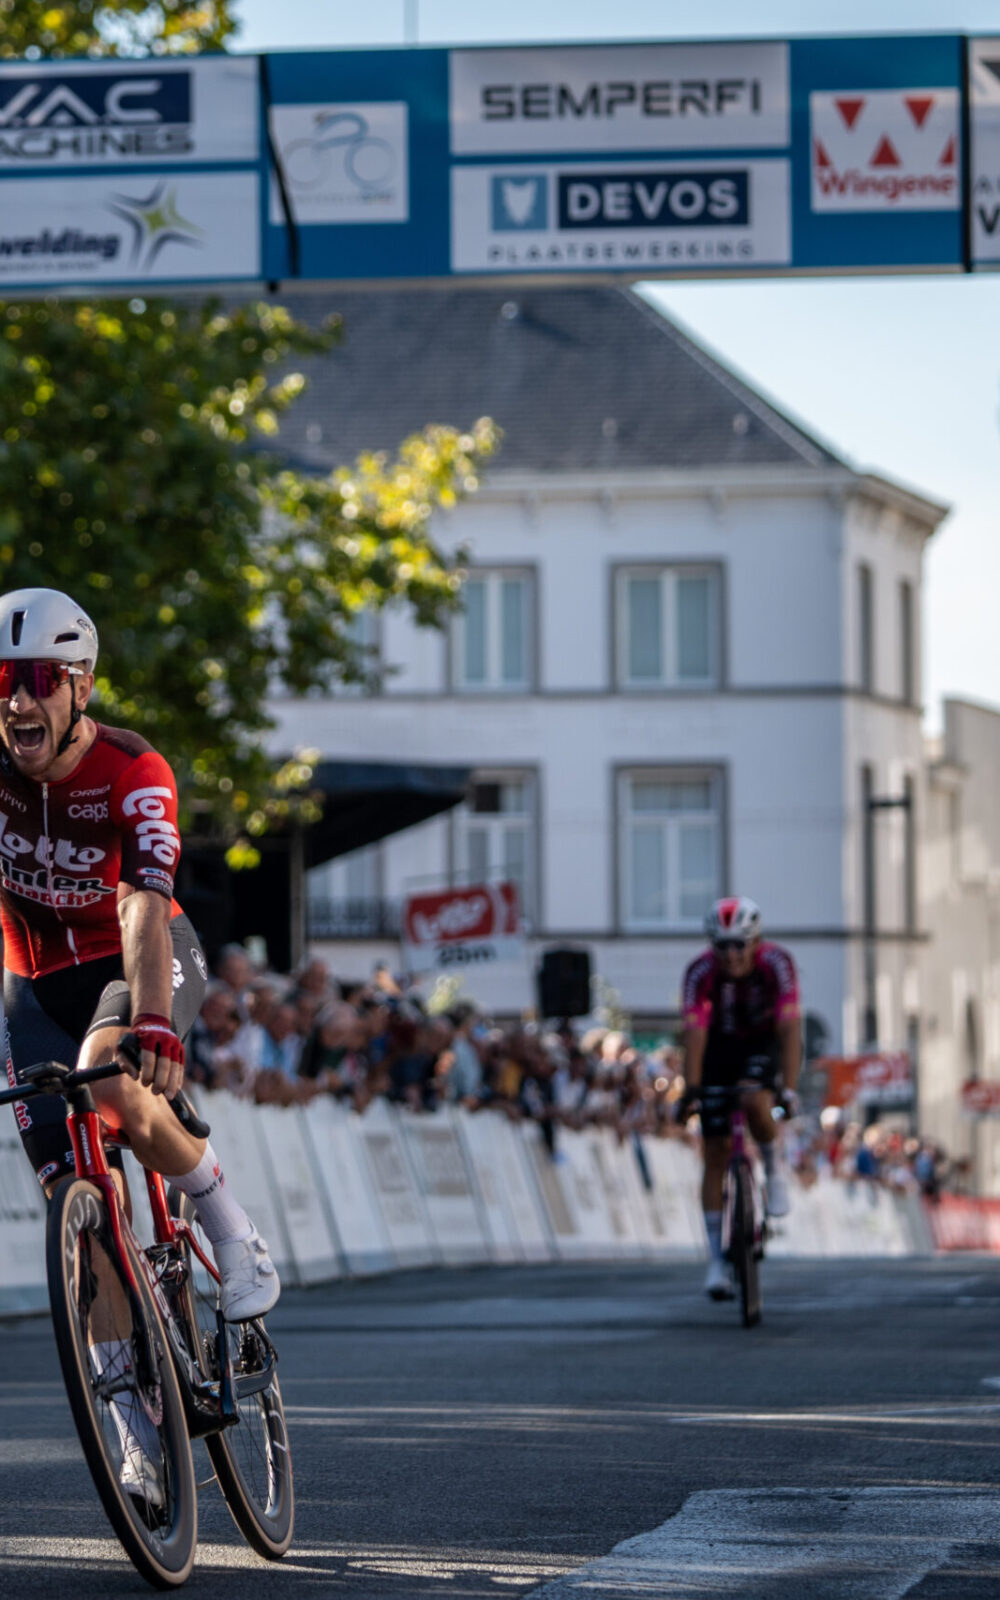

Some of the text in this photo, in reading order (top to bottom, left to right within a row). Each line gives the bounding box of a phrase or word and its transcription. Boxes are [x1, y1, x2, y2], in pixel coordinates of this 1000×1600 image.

[483, 77, 761, 119] SEMPERFI
[567, 179, 741, 221] DEVOS
[817, 168, 956, 203] Wingene
[488, 239, 754, 263] PLAATBEWERKING
[67, 801, 109, 823] caps
[121, 785, 180, 866] lotto
